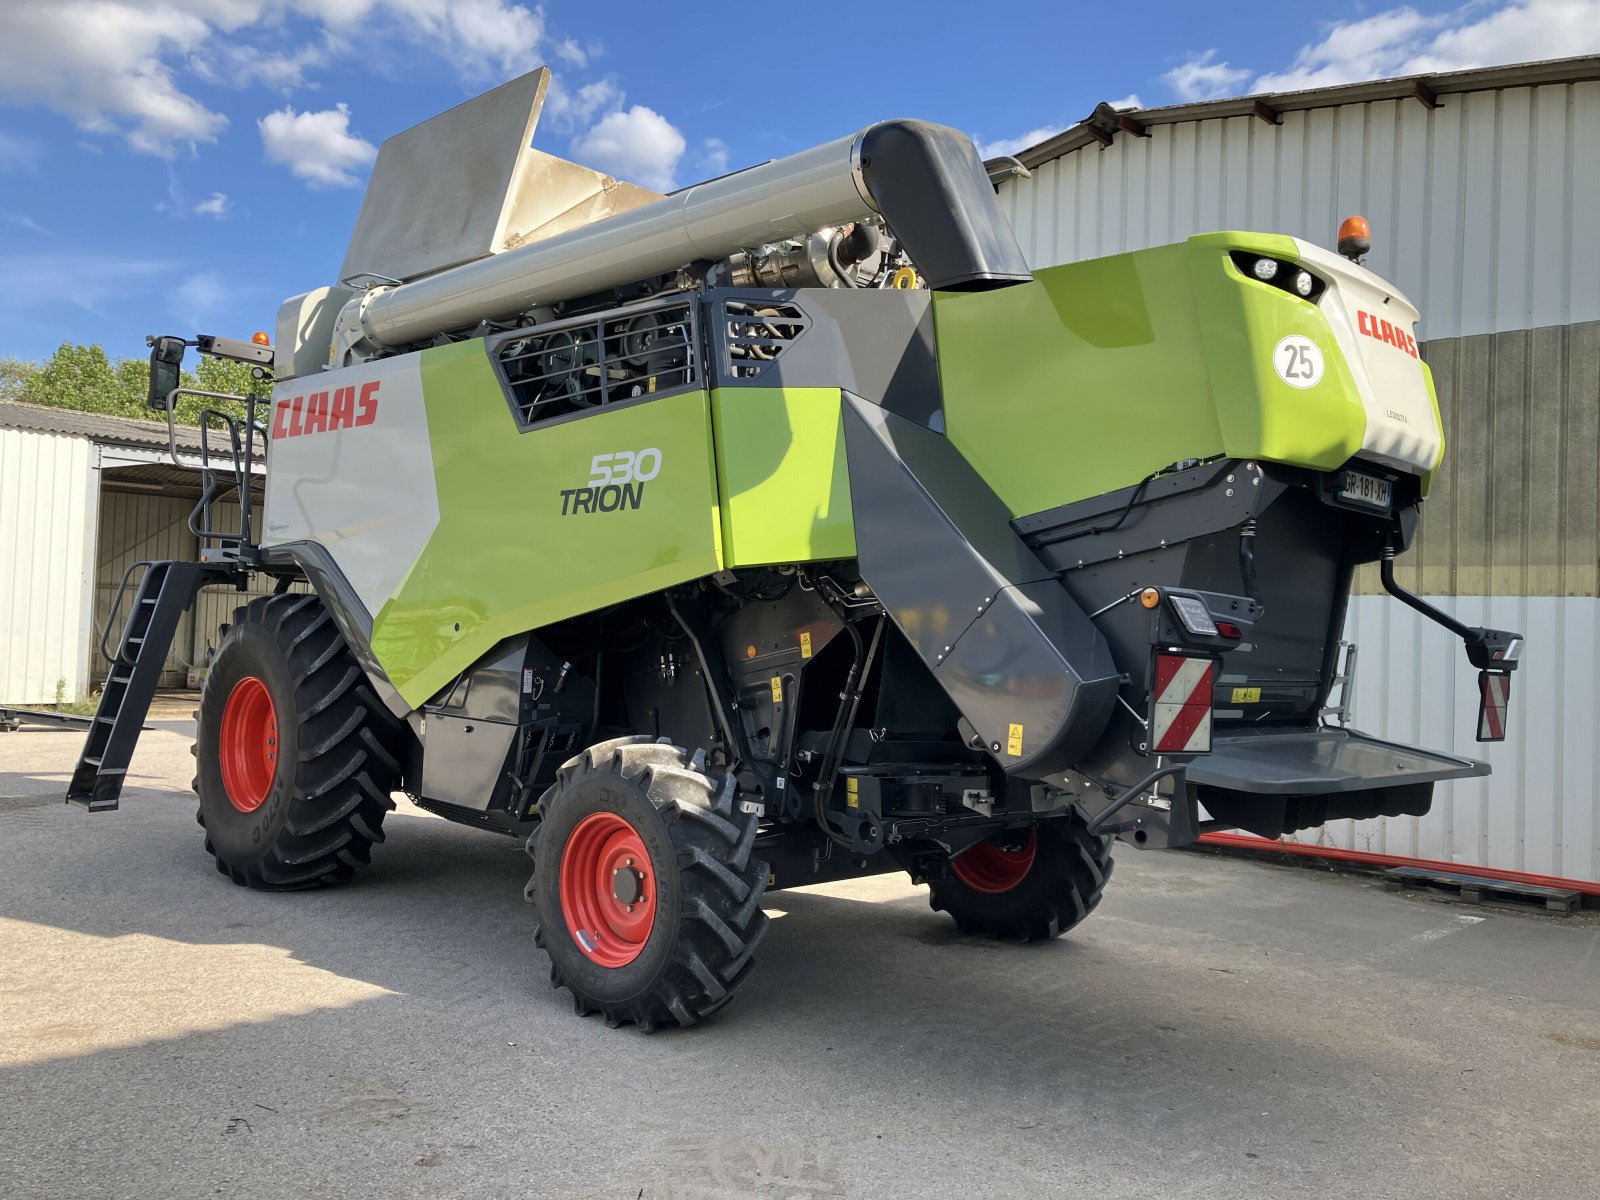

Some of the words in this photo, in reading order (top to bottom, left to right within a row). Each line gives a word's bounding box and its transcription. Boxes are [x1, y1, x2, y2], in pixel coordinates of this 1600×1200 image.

[1357, 310, 1418, 360] CLAAS
[1284, 344, 1314, 379] 25
[272, 380, 381, 440] CLAAS
[587, 447, 663, 488] 530
[560, 481, 645, 516] TRION
